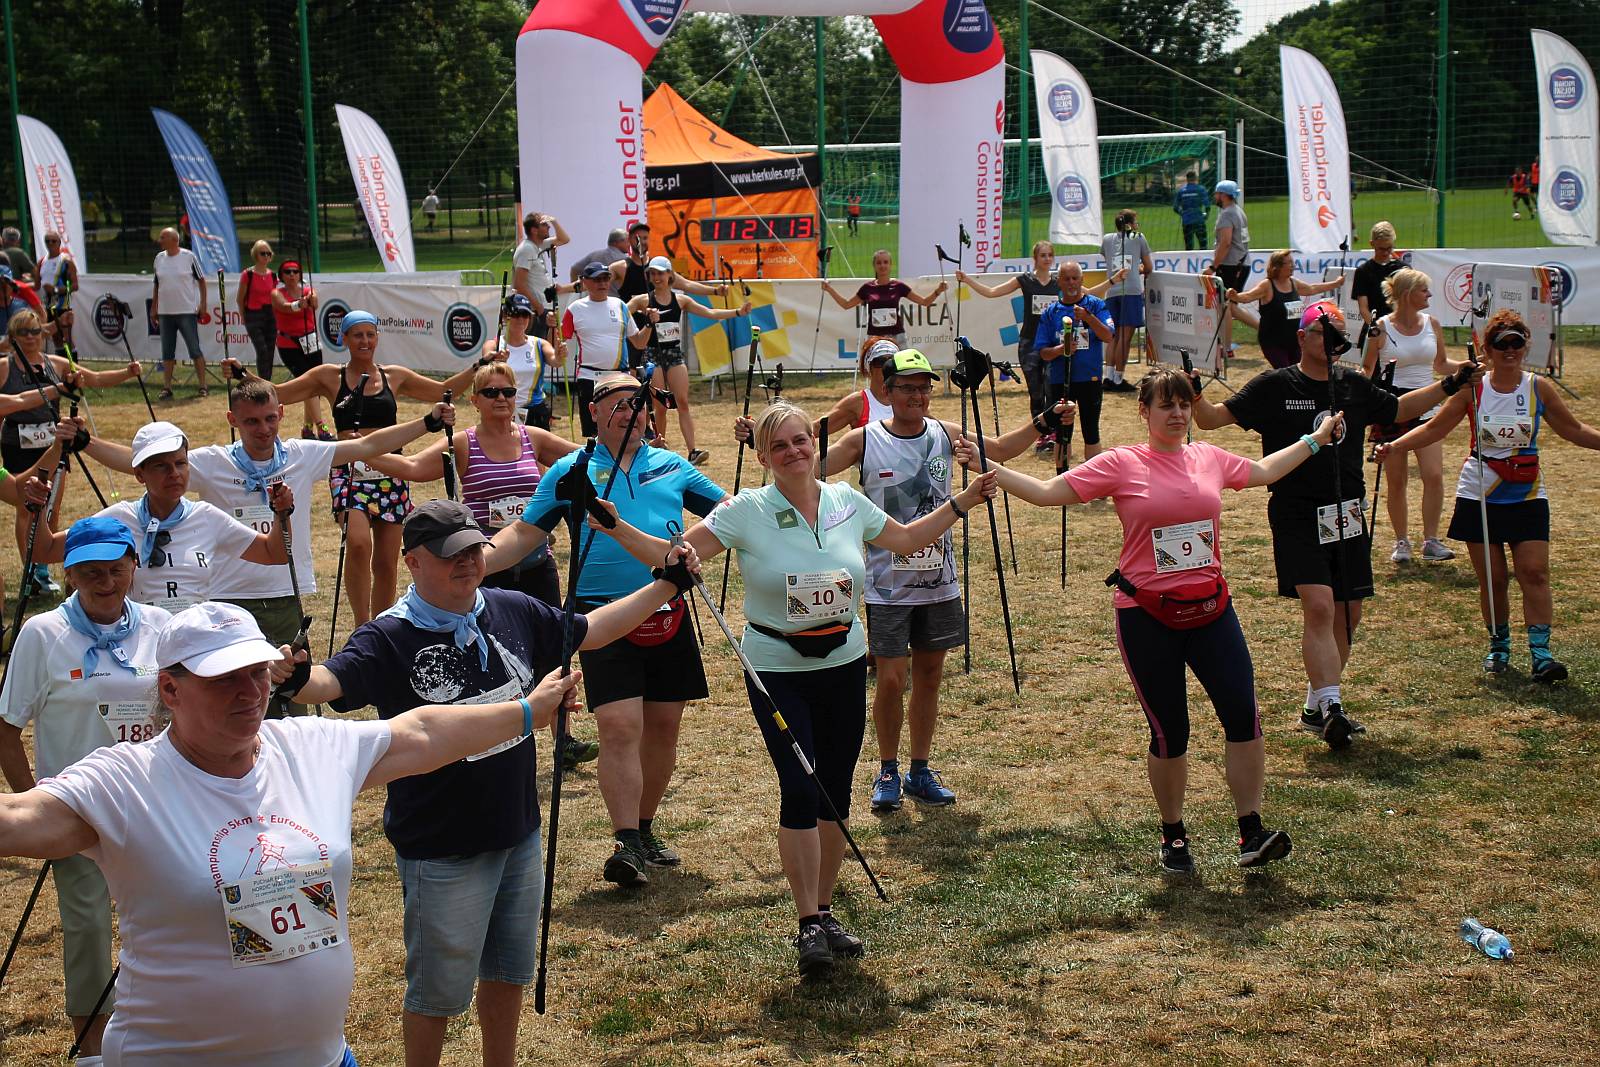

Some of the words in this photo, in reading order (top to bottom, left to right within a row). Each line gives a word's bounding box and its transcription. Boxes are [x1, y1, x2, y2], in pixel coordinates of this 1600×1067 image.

[616, 101, 639, 234] tander
[644, 174, 681, 191] org.pl
[976, 142, 991, 236] Consumer
[976, 241, 988, 273] Ban
[1171, 295, 1188, 308] BOKSY
[376, 316, 433, 330] harPolskiNW.pl
[856, 303, 951, 329] LNICA
[1167, 311, 1193, 325] STARTOWE
[215, 332, 251, 344] Consum
[453, 328, 473, 336] POLSKI
[33, 432, 46, 441] 50
[1498, 427, 1514, 439] 42
[250, 520, 274, 534] 10
[1181, 541, 1193, 556] 9
[166, 581, 178, 598] R
[811, 589, 835, 606] 10
[117, 723, 154, 743] 188
[227, 814, 253, 831] 5km
[270, 813, 320, 843] European
[251, 883, 271, 893] NORDIC
[270, 902, 306, 935] 61
